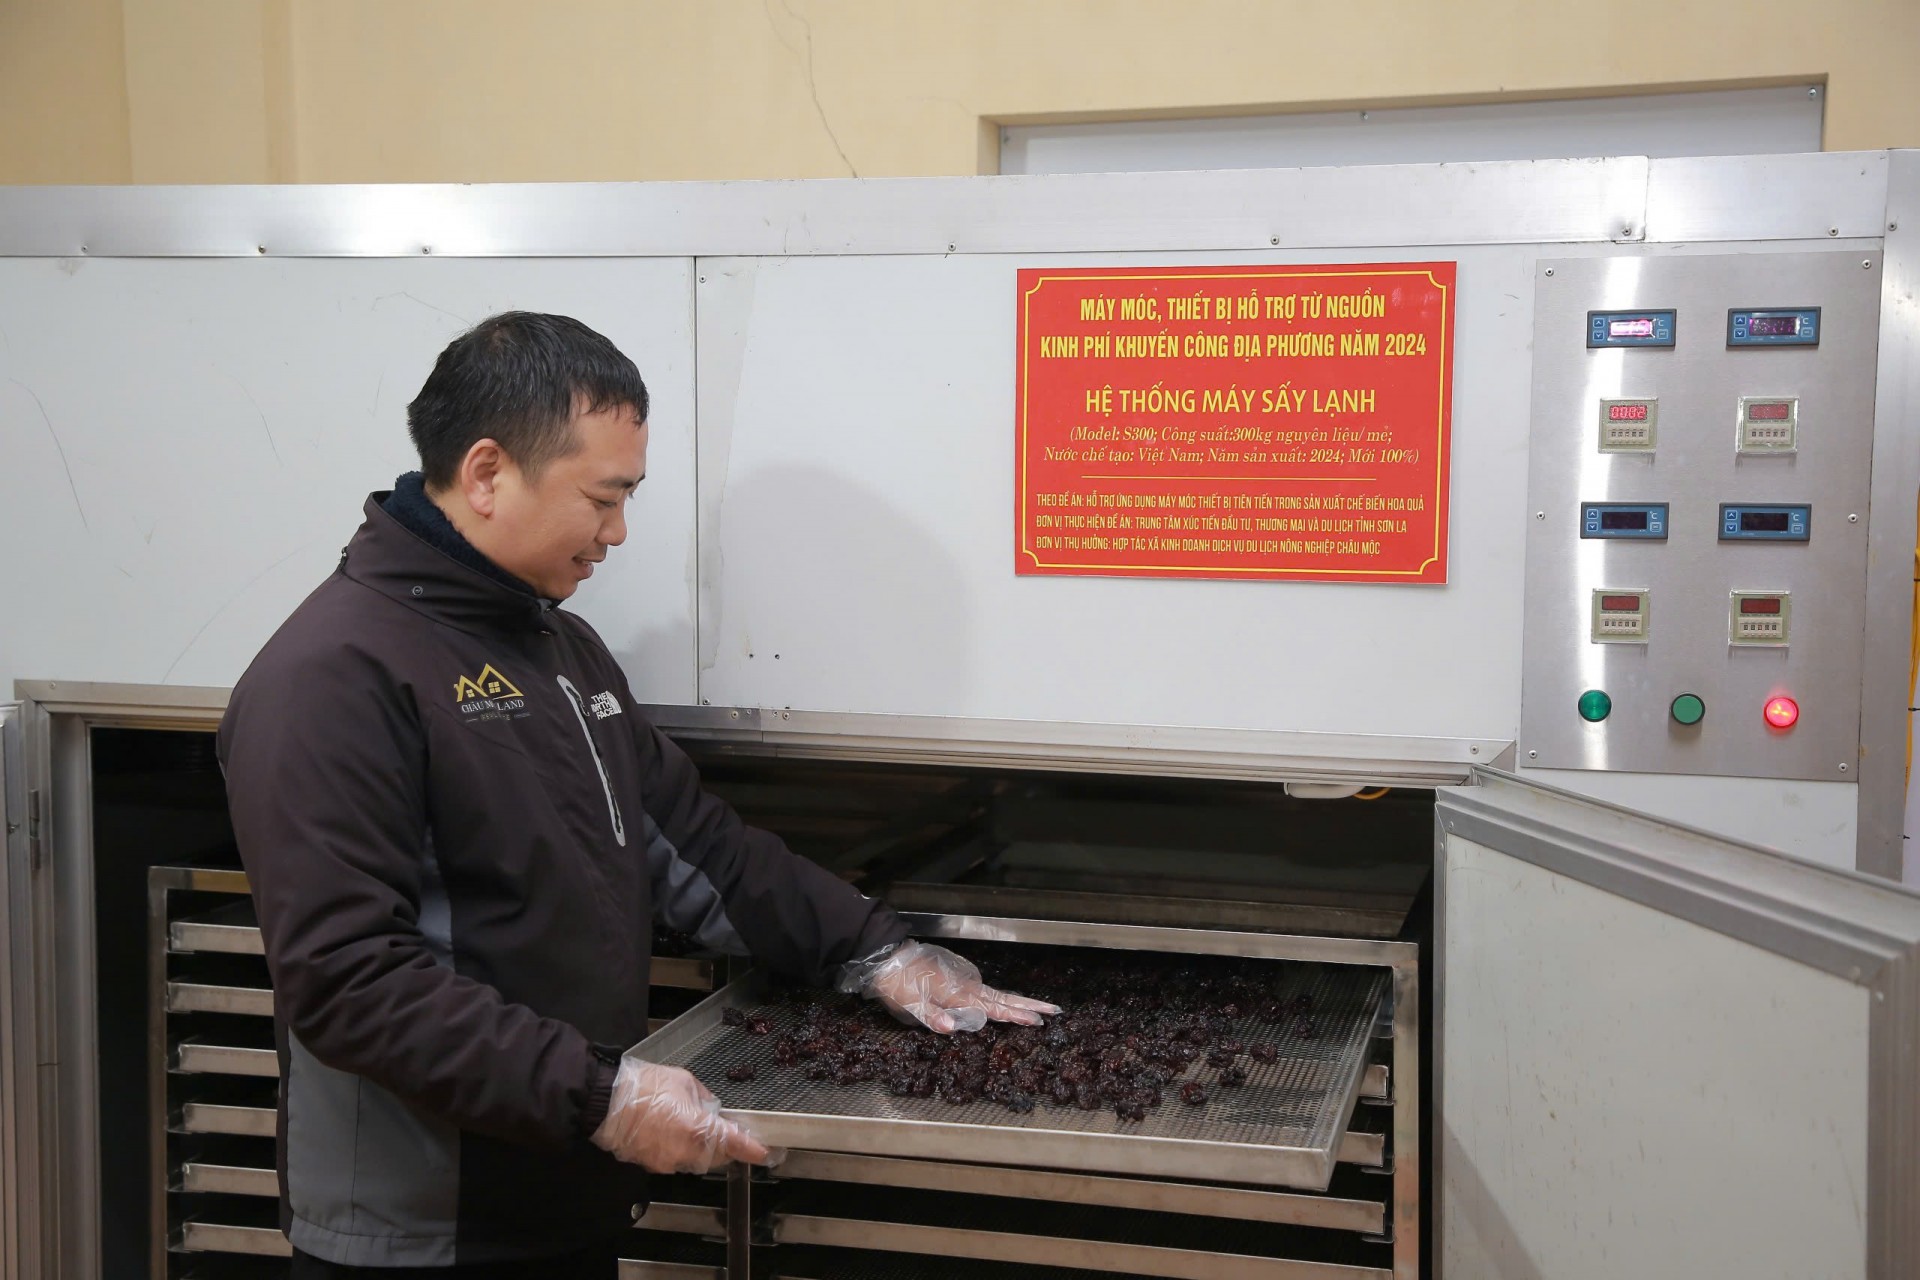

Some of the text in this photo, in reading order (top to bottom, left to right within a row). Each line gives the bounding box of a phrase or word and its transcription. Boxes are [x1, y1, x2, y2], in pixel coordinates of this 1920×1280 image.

[1080, 287, 1385, 325] MÁY MÓC, THIẾT BỊ HỖ TRỢ TỪ NGUỒN
[1040, 328, 1427, 362] KINH PHÍ KHUYẾN CÔNG ĐỊA PHƯƠNG NĂM 2024
[1086, 381, 1375, 417] HỆ THỐNG MÁY SẤY LẠNH
[1070, 426, 1120, 441] (Model:
[1123, 426, 1157, 443] S300;
[1161, 426, 1197, 443] Công
[1276, 428, 1328, 444] nguyên
[1044, 445, 1420, 465] Nước chế tạo: Việt Nam; Năm sản xuất: 2024; Mới 100%)
[1037, 490, 1424, 511] THEO ĐỀ ÁN: HỖ TRỢ ỨNG DỤNG MÁY MÓC THIẾT BỊ TIÊN TIẾN TRONG SẢN XUẤT CHẾ BIẾN HOA QUẢ
[1036, 515, 1052, 527] ĐƠN
[1055, 516, 1062, 530] VỊ
[1087, 514, 1105, 530] HIỆN
[1107, 513, 1118, 528] ĐỀ
[1120, 514, 1133, 528] ÁN:
[1136, 517, 1162, 529] TRUNG
[1164, 515, 1181, 529] TÂM
[1183, 515, 1199, 529] XÚC
[1202, 514, 1219, 530] TIẾN
[1256, 518, 1287, 531] THƯƠNG
[1290, 519, 1305, 534] MẠI
[1308, 517, 1319, 531] VÀ
[1321, 519, 1333, 532] DU
[1335, 520, 1353, 534] LỊCH
[1355, 516, 1375, 533] TỈNH
[1377, 519, 1394, 533] SƠN
[1397, 520, 1407, 533] LA
[1036, 536, 1052, 548] ĐƠN
[1055, 537, 1062, 551] VỊ
[1064, 537, 1080, 551] THỤ
[1113, 538, 1128, 552] HỢP
[1131, 536, 1146, 550] TÁC
[1148, 536, 1159, 551] XÃ
[1161, 539, 1180, 551] KINH
[1183, 539, 1210, 551] DOANH
[1213, 540, 1231, 554] DỊCH
[1234, 540, 1244, 554] VỤ
[1247, 540, 1257, 552] DU
[1260, 540, 1278, 555] LỊCH
[1280, 538, 1302, 553] NÔNG
[1305, 539, 1335, 556] NGHIỆP
[1337, 539, 1359, 554] CHÂU
[1362, 539, 1380, 557] MỘC
[497, 699, 524, 710] LAND
[591, 693, 607, 703] THE
[596, 708, 614, 720] FACE
